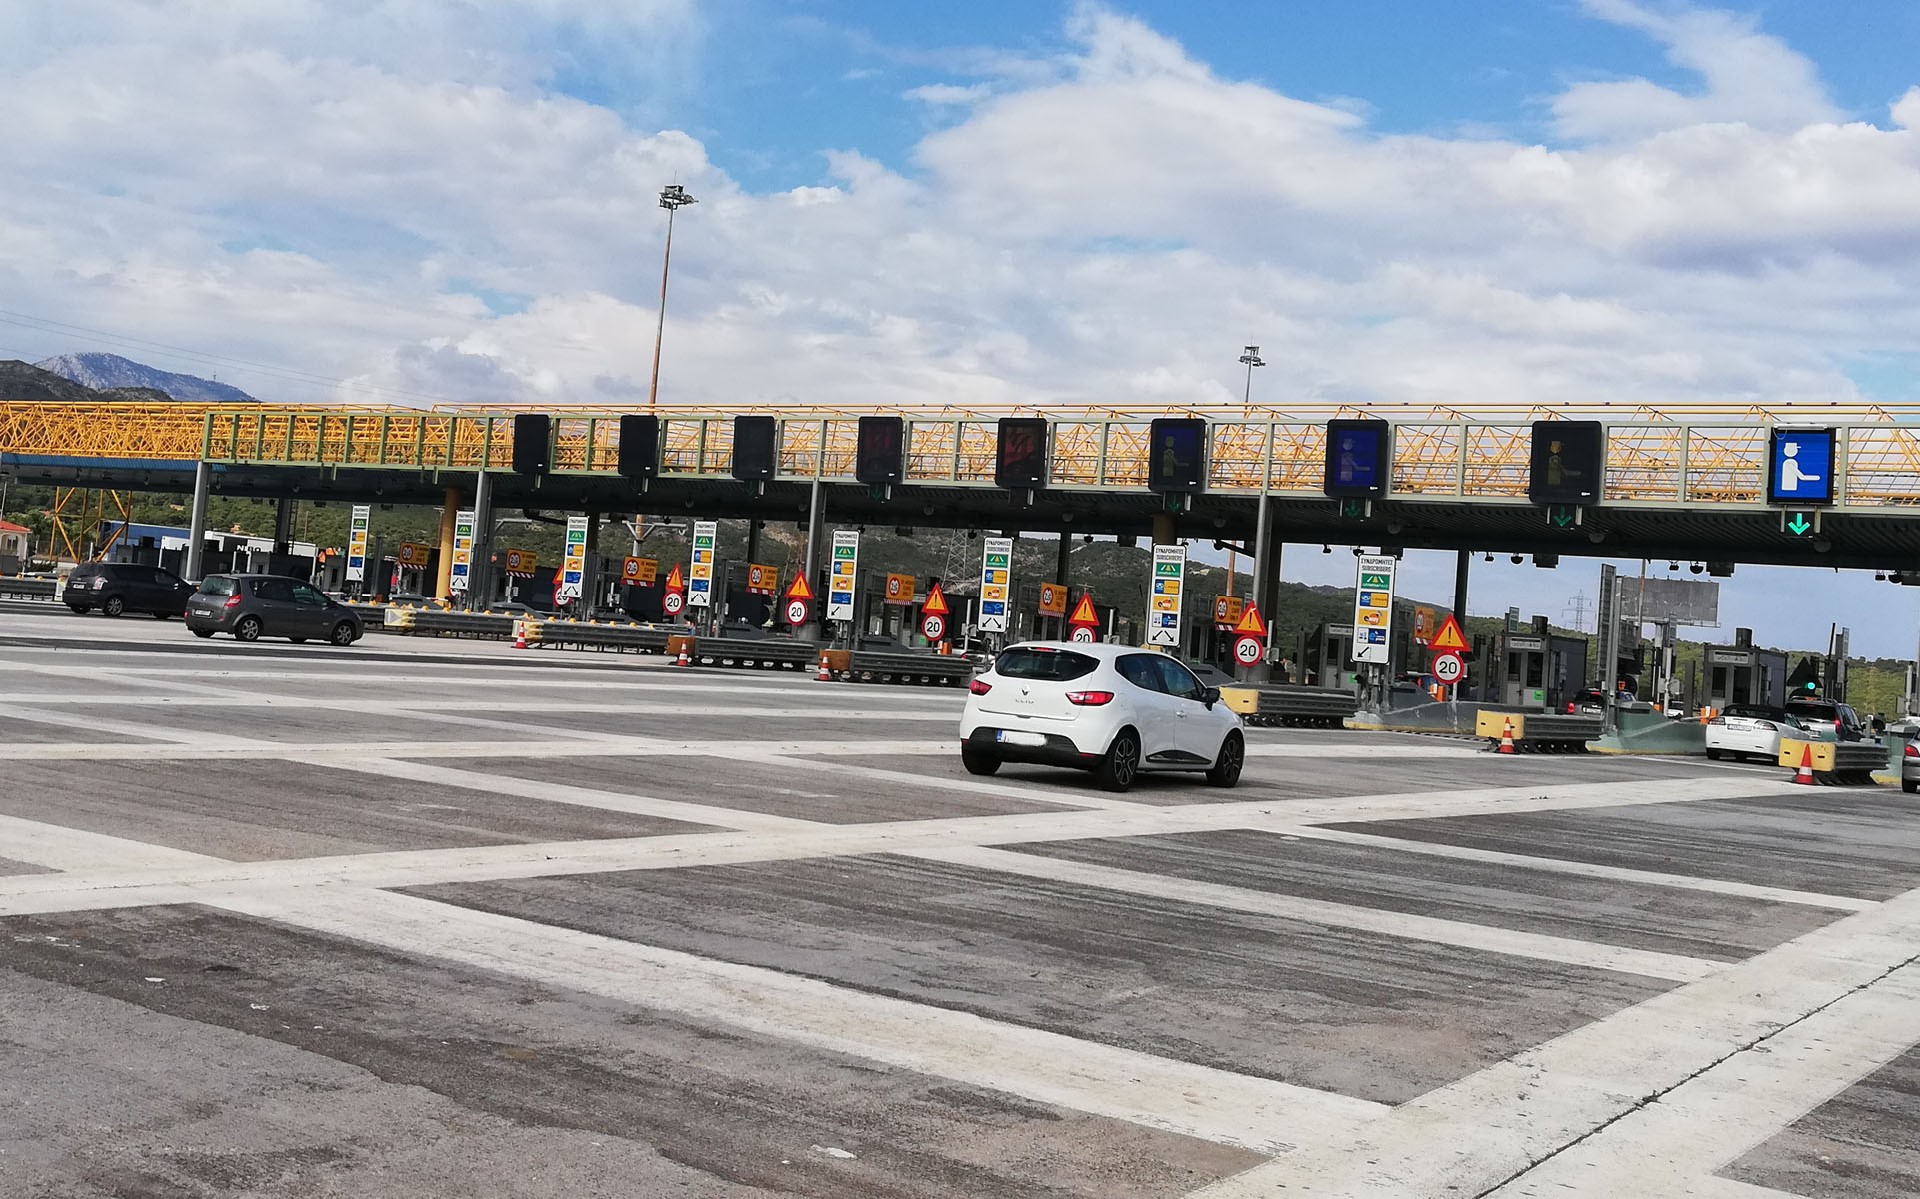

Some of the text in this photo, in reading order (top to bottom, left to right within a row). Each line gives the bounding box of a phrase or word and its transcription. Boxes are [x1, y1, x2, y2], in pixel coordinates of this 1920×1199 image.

[1360, 558, 1393, 566] ΣΥΝΔΡΟΜΗΤΕΣ
[667, 597, 680, 608] 20
[790, 606, 802, 617] 20
[926, 621, 940, 633] 20
[1076, 633, 1091, 642] 20
[1240, 644, 1257, 657] 20
[1438, 661, 1457, 674] 20
